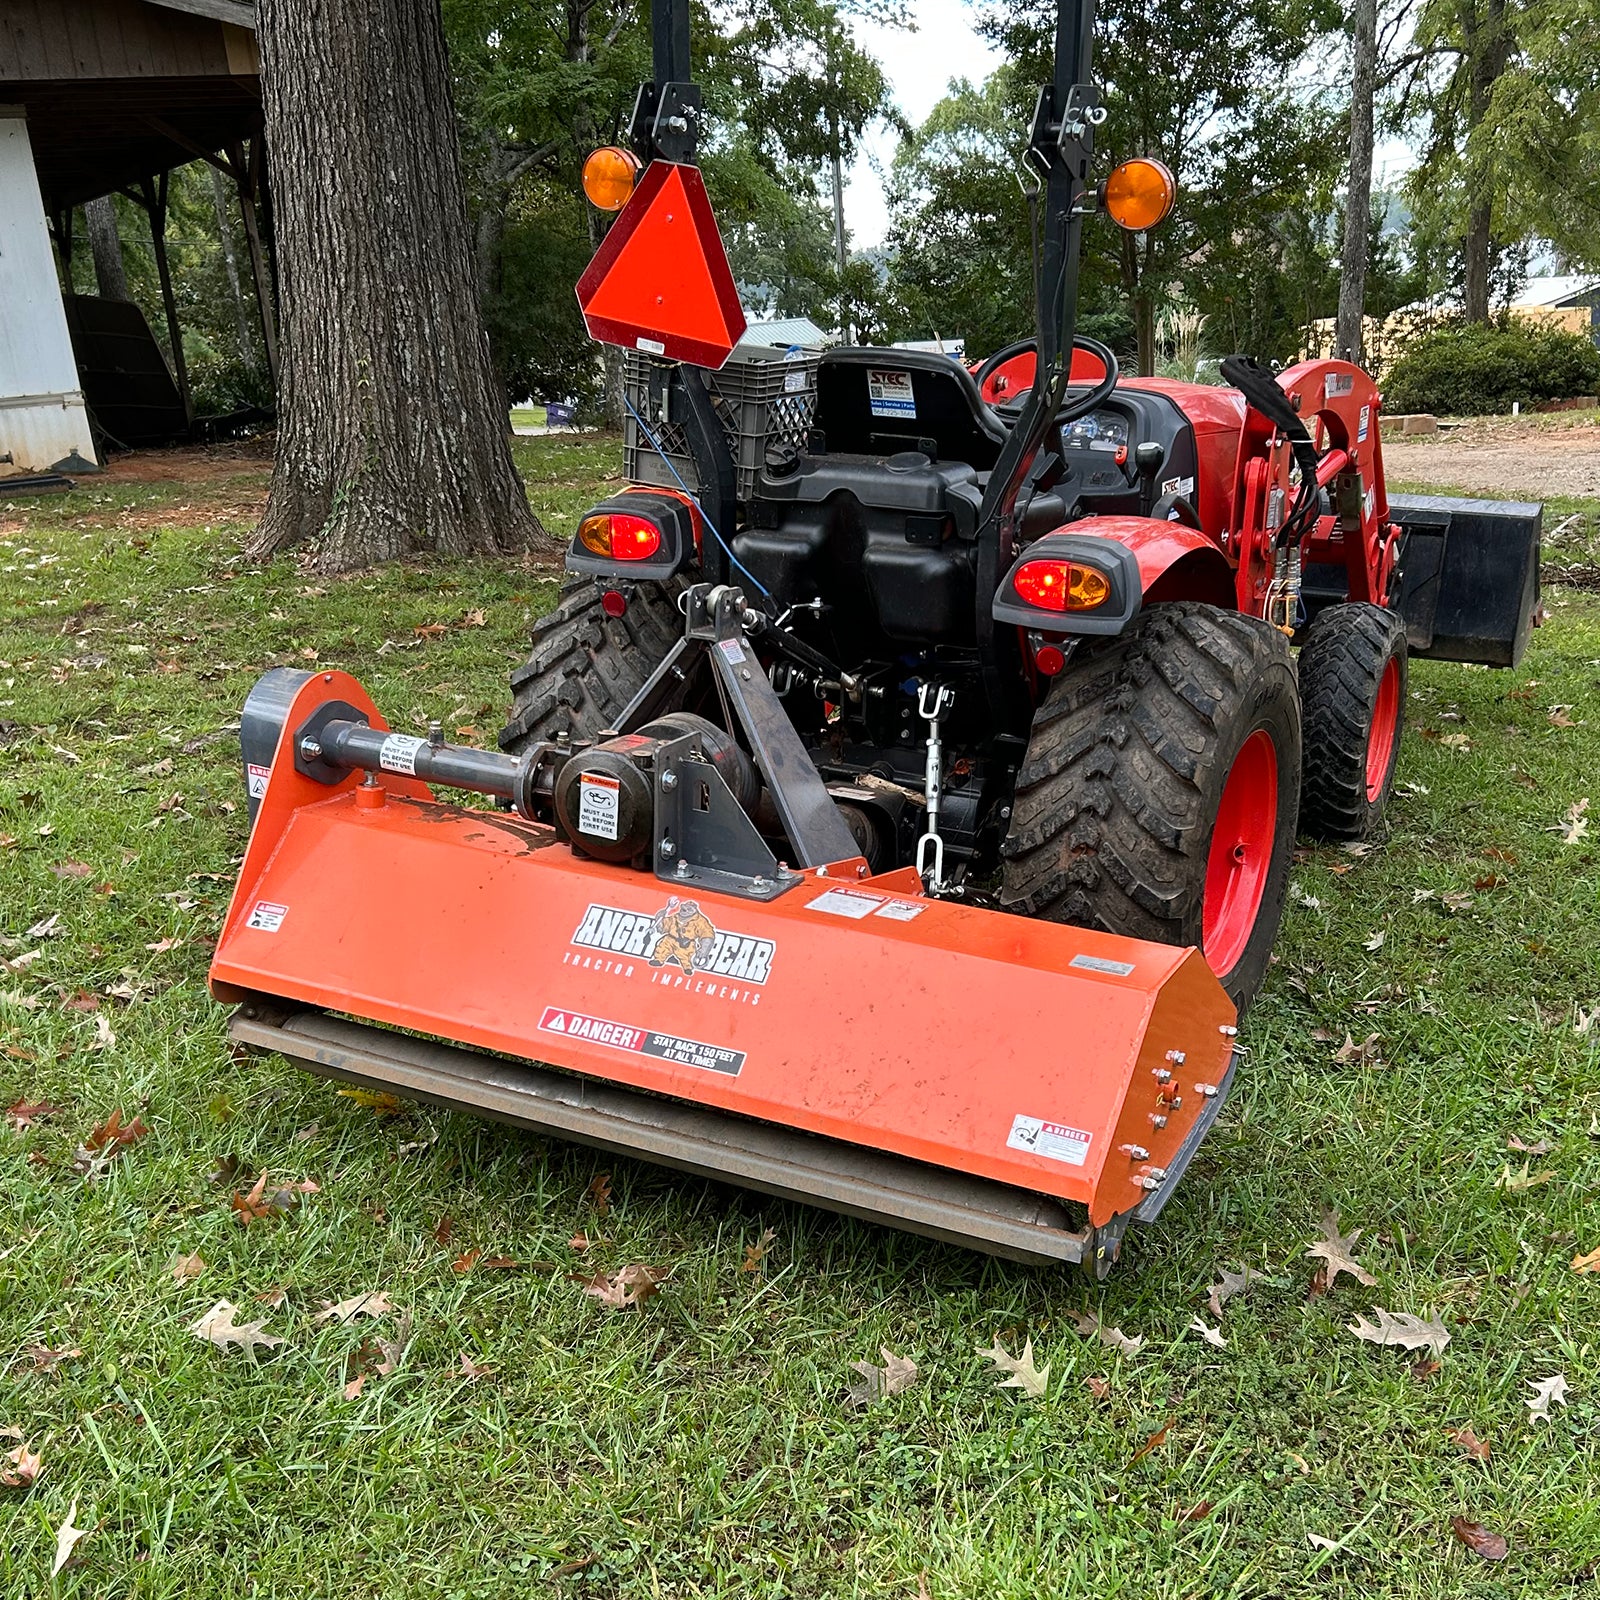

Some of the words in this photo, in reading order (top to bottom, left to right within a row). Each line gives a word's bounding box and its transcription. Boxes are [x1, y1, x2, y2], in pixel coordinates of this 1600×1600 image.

[870, 371, 907, 385] STEC
[1163, 479, 1179, 495] STEC
[391, 755, 413, 764] BEFORE
[581, 814, 591, 822] OIL
[592, 817, 615, 827] BEFORE
[583, 808, 600, 816] MUST
[601, 812, 615, 820] ADD
[582, 822, 600, 830] FIRST
[574, 906, 660, 958] ANGRY
[706, 932, 774, 983] BEAR
[562, 951, 635, 978] TRACTOR
[651, 971, 762, 1006] IMPLEMENTS
[567, 1016, 641, 1048] DANGER!
[653, 1035, 676, 1048] STAY
[675, 1038, 698, 1054] BACK
[698, 1044, 715, 1059] 150
[714, 1049, 737, 1064] FEET
[663, 1048, 676, 1060] AT
[675, 1050, 690, 1063] ALL
[689, 1053, 716, 1069] TIMES
[1053, 1127, 1087, 1141] DANGER
